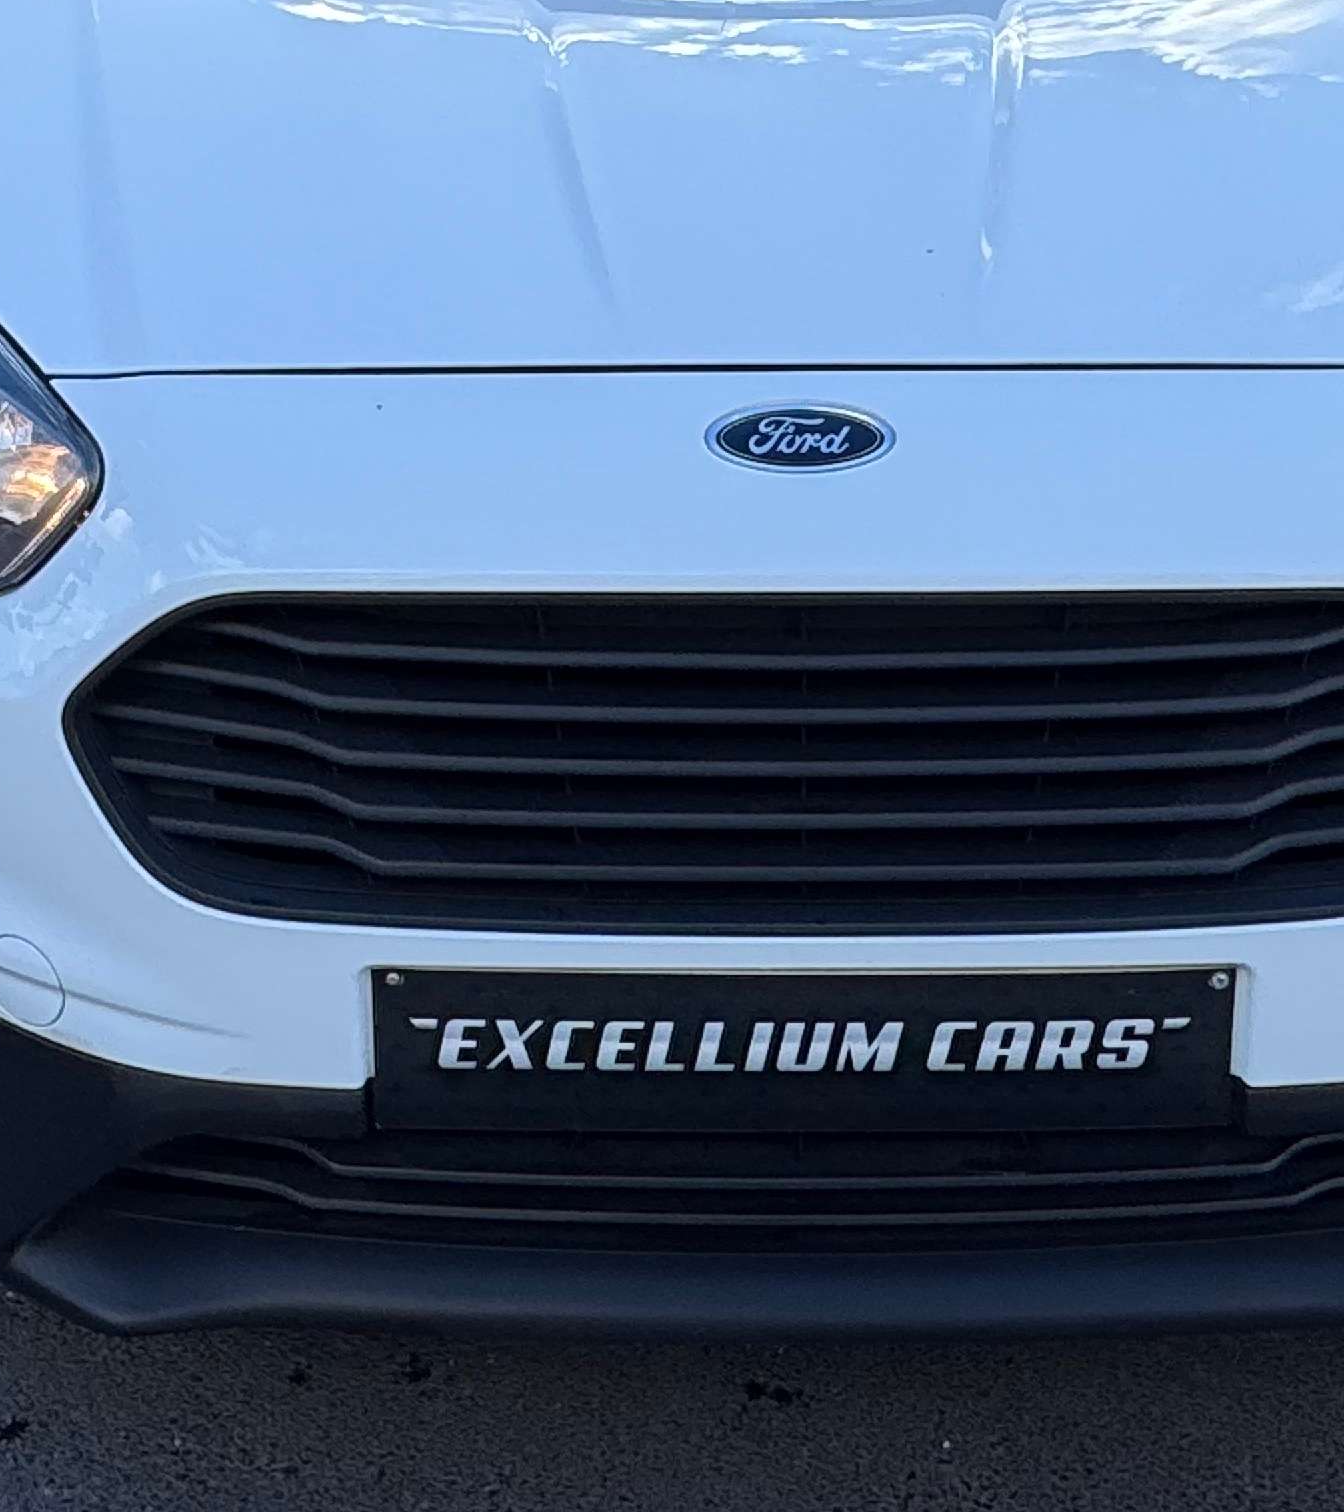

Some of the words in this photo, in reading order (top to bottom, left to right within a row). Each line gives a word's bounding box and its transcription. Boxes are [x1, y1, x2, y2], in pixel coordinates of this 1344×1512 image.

[749, 416, 851, 455] Ford
[439, 1018, 903, 1072] EXCELLIUM
[927, 1018, 1154, 1071] CARS
